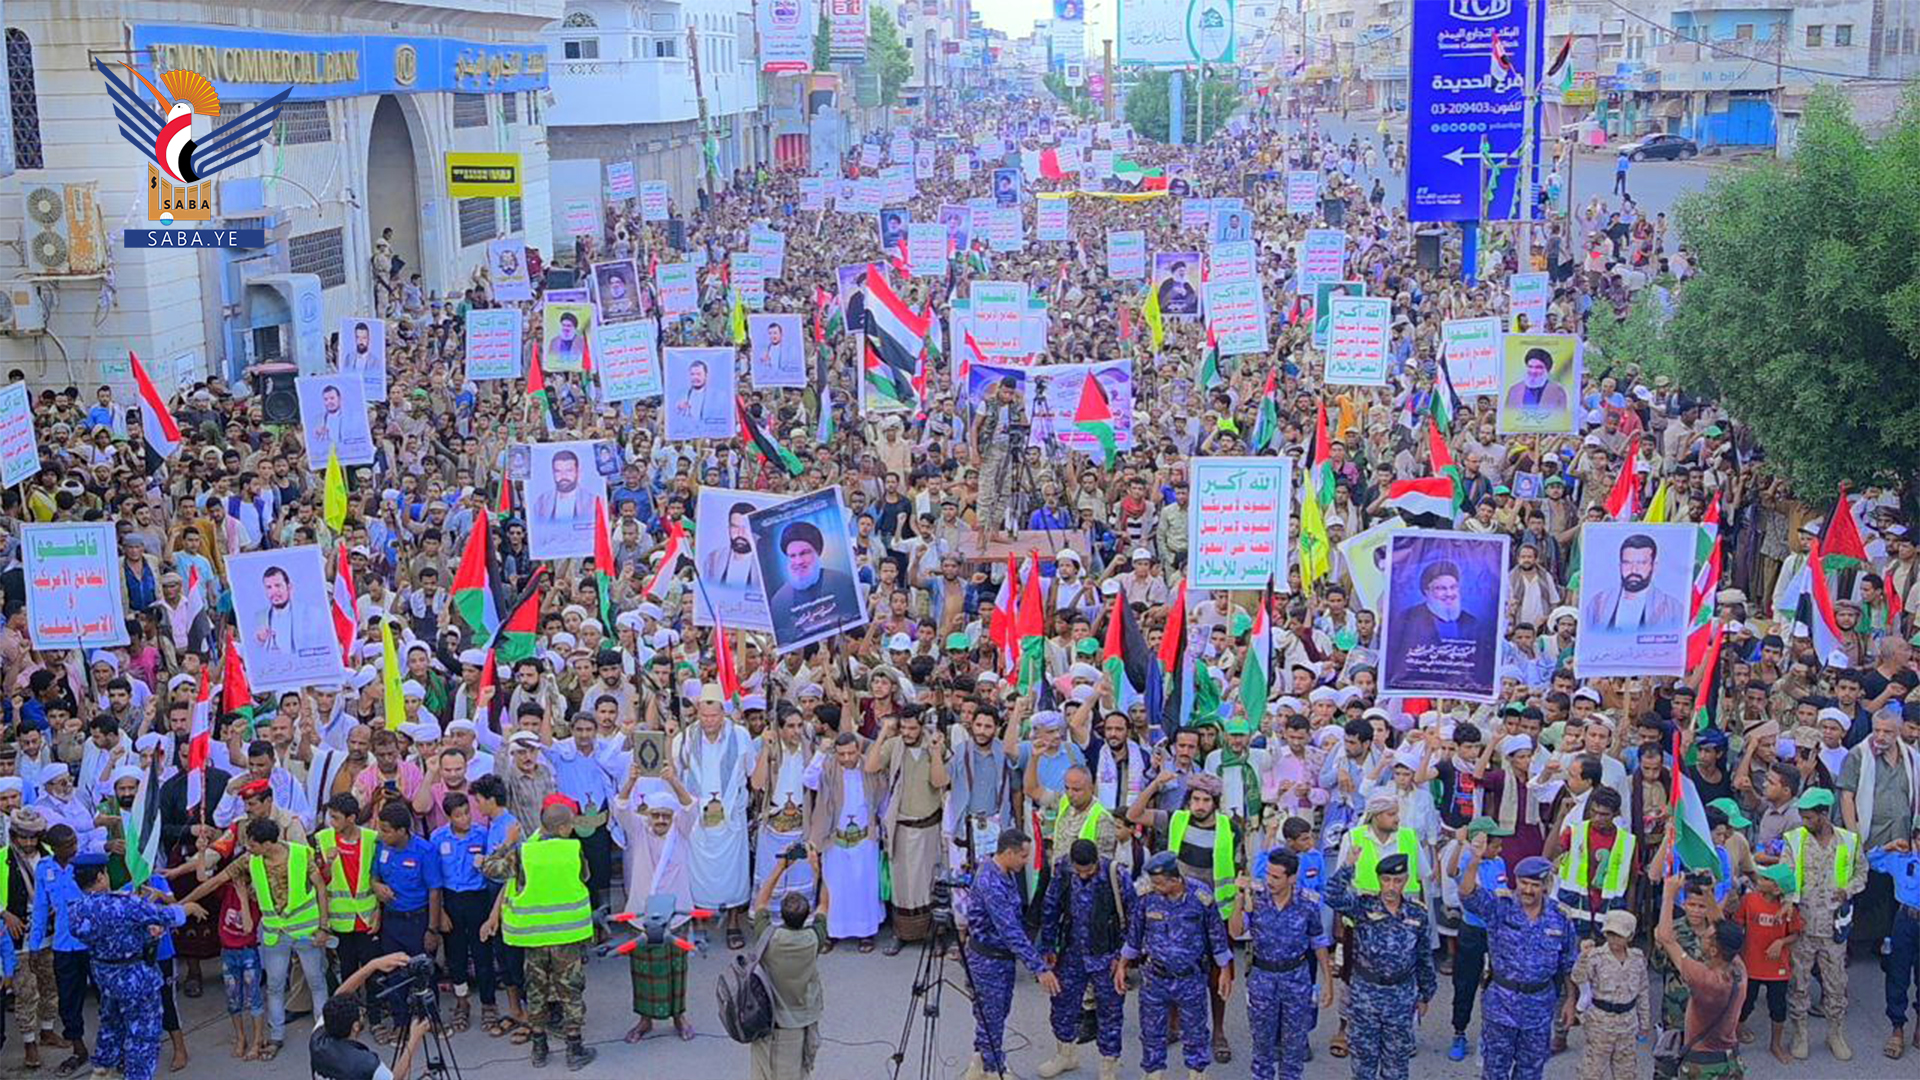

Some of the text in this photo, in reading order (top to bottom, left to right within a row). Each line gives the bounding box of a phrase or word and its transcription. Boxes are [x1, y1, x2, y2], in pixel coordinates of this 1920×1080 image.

[152, 44, 218, 81] YEMEN
[221, 46, 318, 84] COMMERCIAL
[324, 50, 359, 82] BANK
[1432, 74, 1492, 93] الحديدة
[31, 530, 98, 563] قاطعوا
